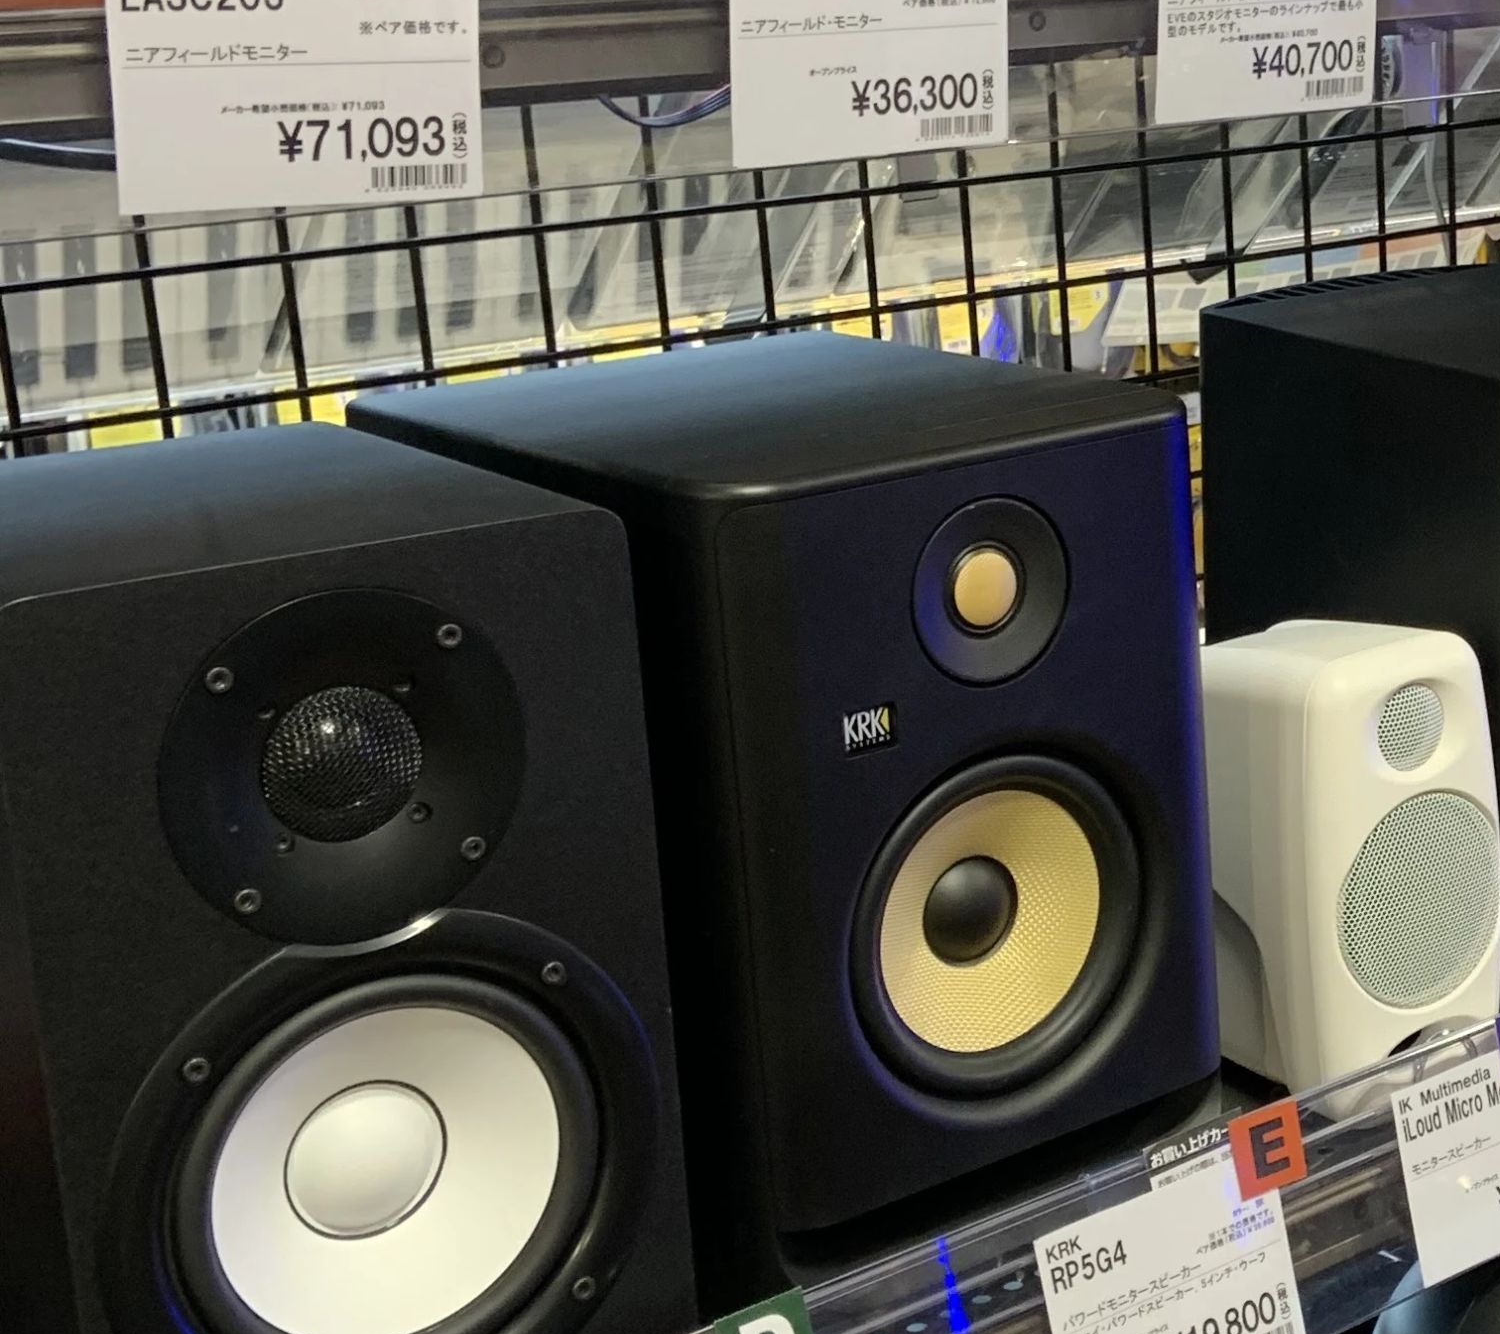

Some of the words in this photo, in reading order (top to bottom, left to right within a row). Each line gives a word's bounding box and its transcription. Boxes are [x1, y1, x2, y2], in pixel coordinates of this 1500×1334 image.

[741, 14, 882, 34] ニアフィールド・モニター
[125, 44, 308, 62] ニアフィールドモニター
[1252, 40, 1353, 80] ¥40,700
[851, 73, 978, 116] ¥36,300
[277, 116, 446, 163] ¥71,093
[843, 707, 886, 745] KRK
[1399, 1096, 1412, 1115] IK
[1419, 1068, 1492, 1105] Multimedia
[1402, 1113, 1443, 1143] iLoud
[1446, 1094, 1483, 1125] Micro
[1249, 1117, 1290, 1179] E
[1411, 1136, 1492, 1175] モニタースピーカー
[1046, 1235, 1082, 1264] KRK
[1050, 1240, 1127, 1294] RP5G4
[1063, 1263, 1202, 1331] パワードモニタースピーカー
